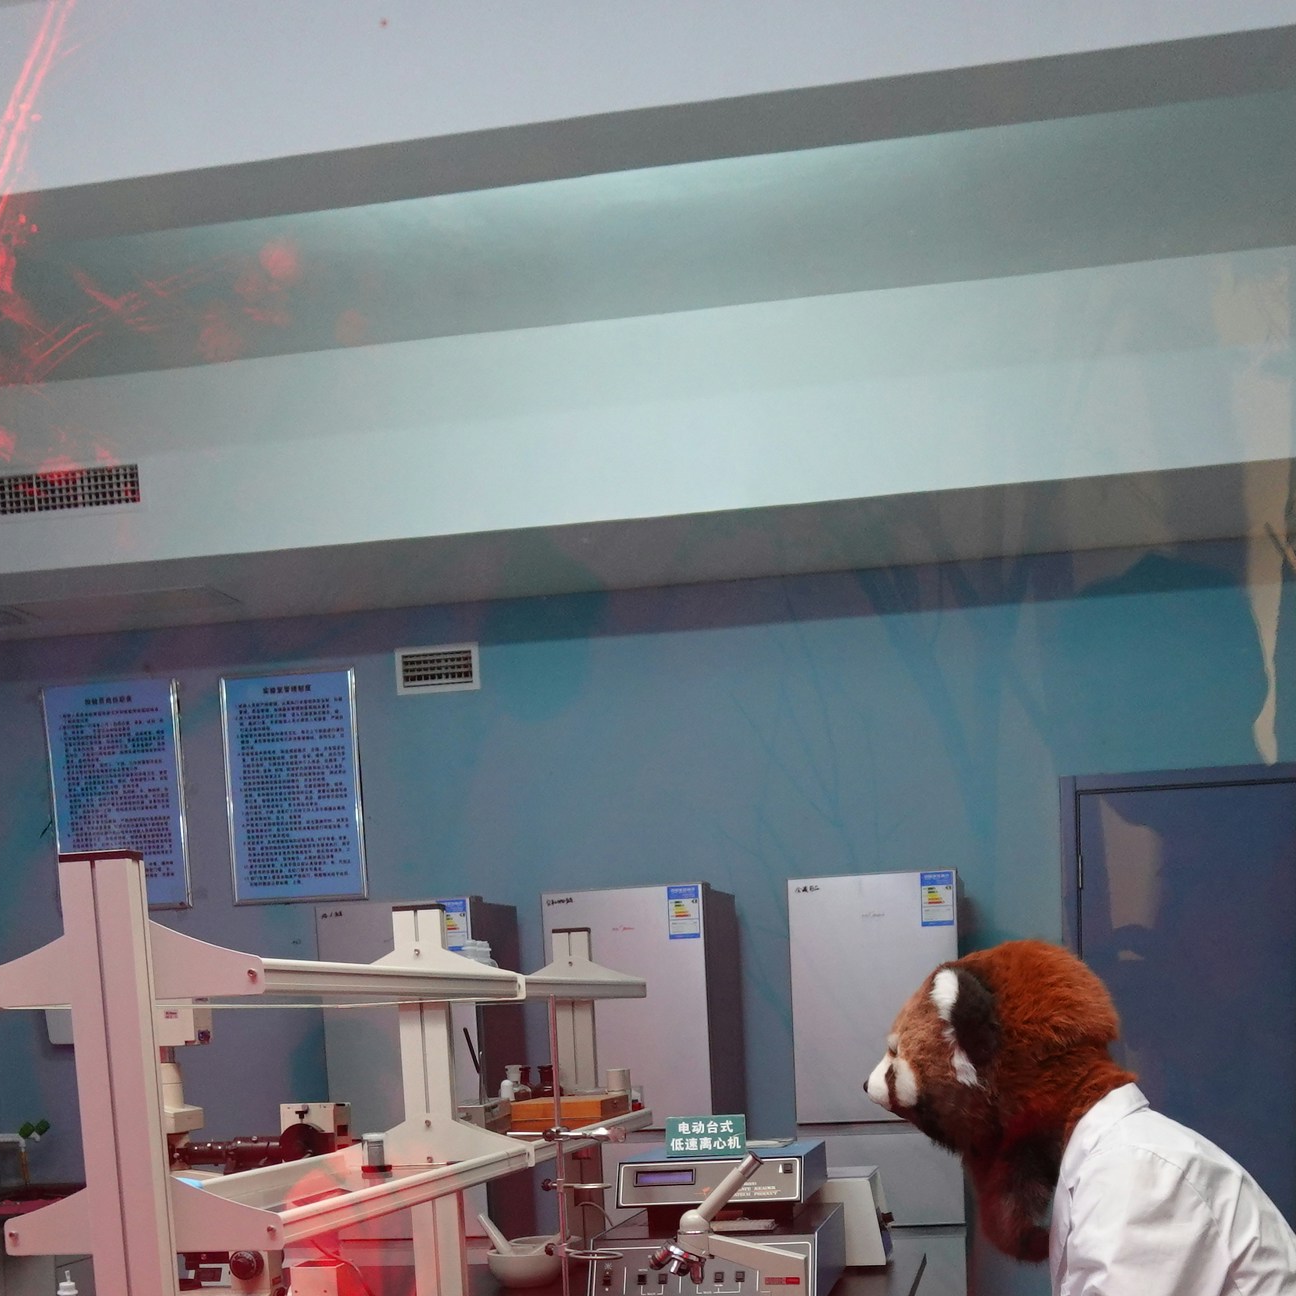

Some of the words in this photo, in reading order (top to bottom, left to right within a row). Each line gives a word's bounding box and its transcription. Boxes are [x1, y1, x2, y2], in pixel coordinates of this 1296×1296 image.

[678, 1120, 734, 1135] 电动台式
[670, 1136, 742, 1151] 低速离心机
